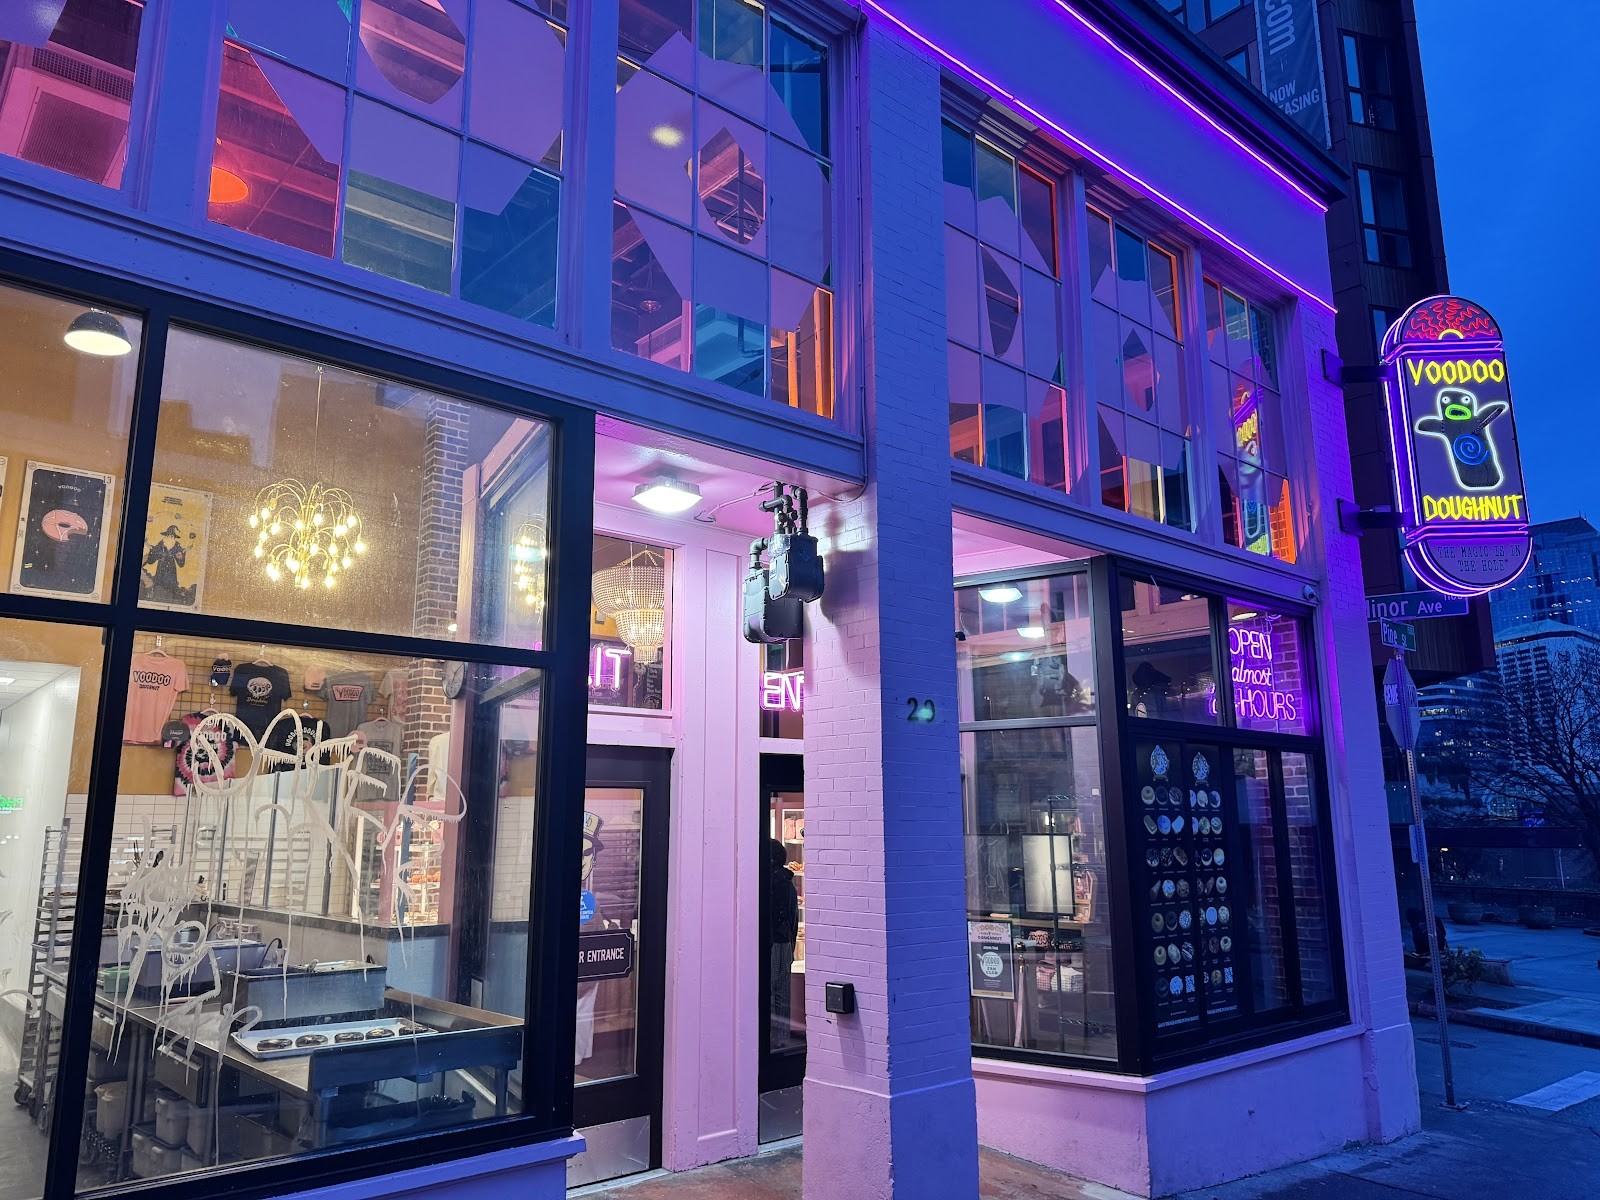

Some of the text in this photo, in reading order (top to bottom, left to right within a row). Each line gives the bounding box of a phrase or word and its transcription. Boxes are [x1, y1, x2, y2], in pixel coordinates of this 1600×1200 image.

[1269, 80, 1296, 104] NOW
[1279, 88, 1320, 116] ASING
[1407, 358, 1505, 386] VOODOO
[1422, 494, 1524, 522] DOUGHNUT
[1438, 543, 1521, 559] THE MAGIC IS IN
[1458, 560, 1477, 572] THE
[1417, 600, 1443, 615] Ave
[1229, 627, 1273, 661] OPEN
[1383, 623, 1398, 645] Pine
[133, 671, 171, 687] VOODOO
[1232, 659, 1272, 686] almost
[1239, 688, 1296, 720] HOURS
[587, 947, 625, 963] ENTRANCE
